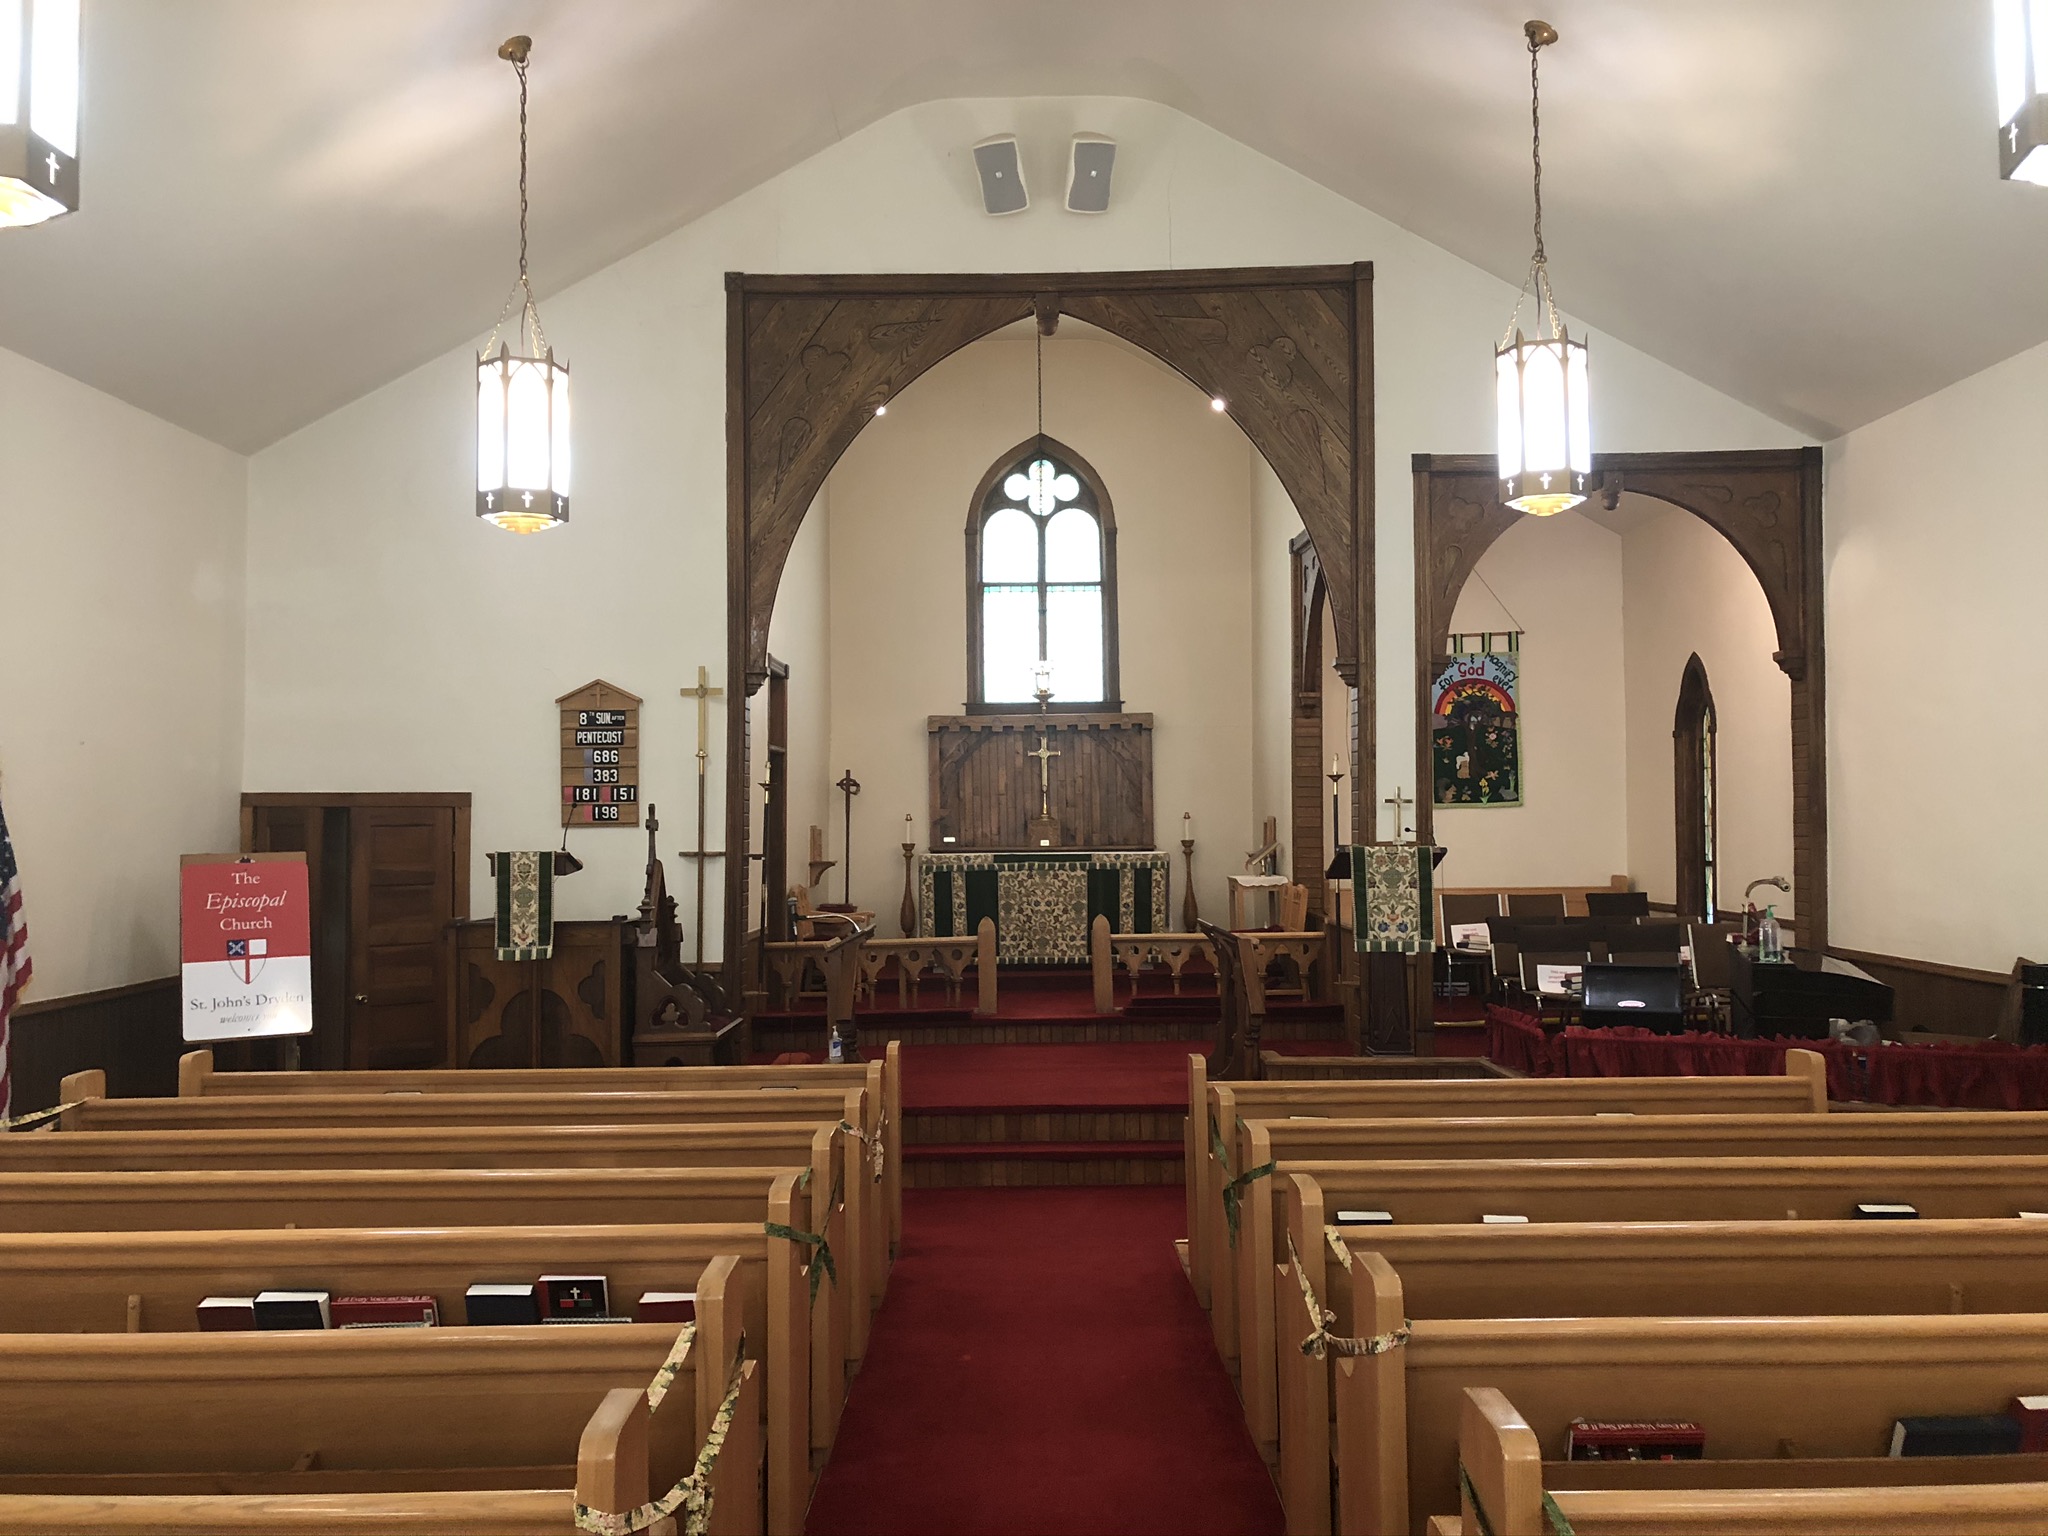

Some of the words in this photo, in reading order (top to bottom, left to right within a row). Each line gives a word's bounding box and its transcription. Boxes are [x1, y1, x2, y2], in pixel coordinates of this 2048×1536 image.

[1457, 660, 1485, 678] God
[1492, 674, 1513, 691] ever
[576, 731, 623, 744] PENTECOST
[593, 750, 618, 763] 686
[593, 769, 618, 782] 383
[576, 787, 597, 801] 181
[613, 787, 634, 801] 151
[594, 806, 618, 819] 198
[231, 871, 261, 885] The
[205, 890, 287, 914] Episcopal
[220, 916, 273, 931] Church
[190, 998, 208, 1010] St.
[211, 995, 251, 1013] John's
[256, 992, 304, 1006] Dryden
